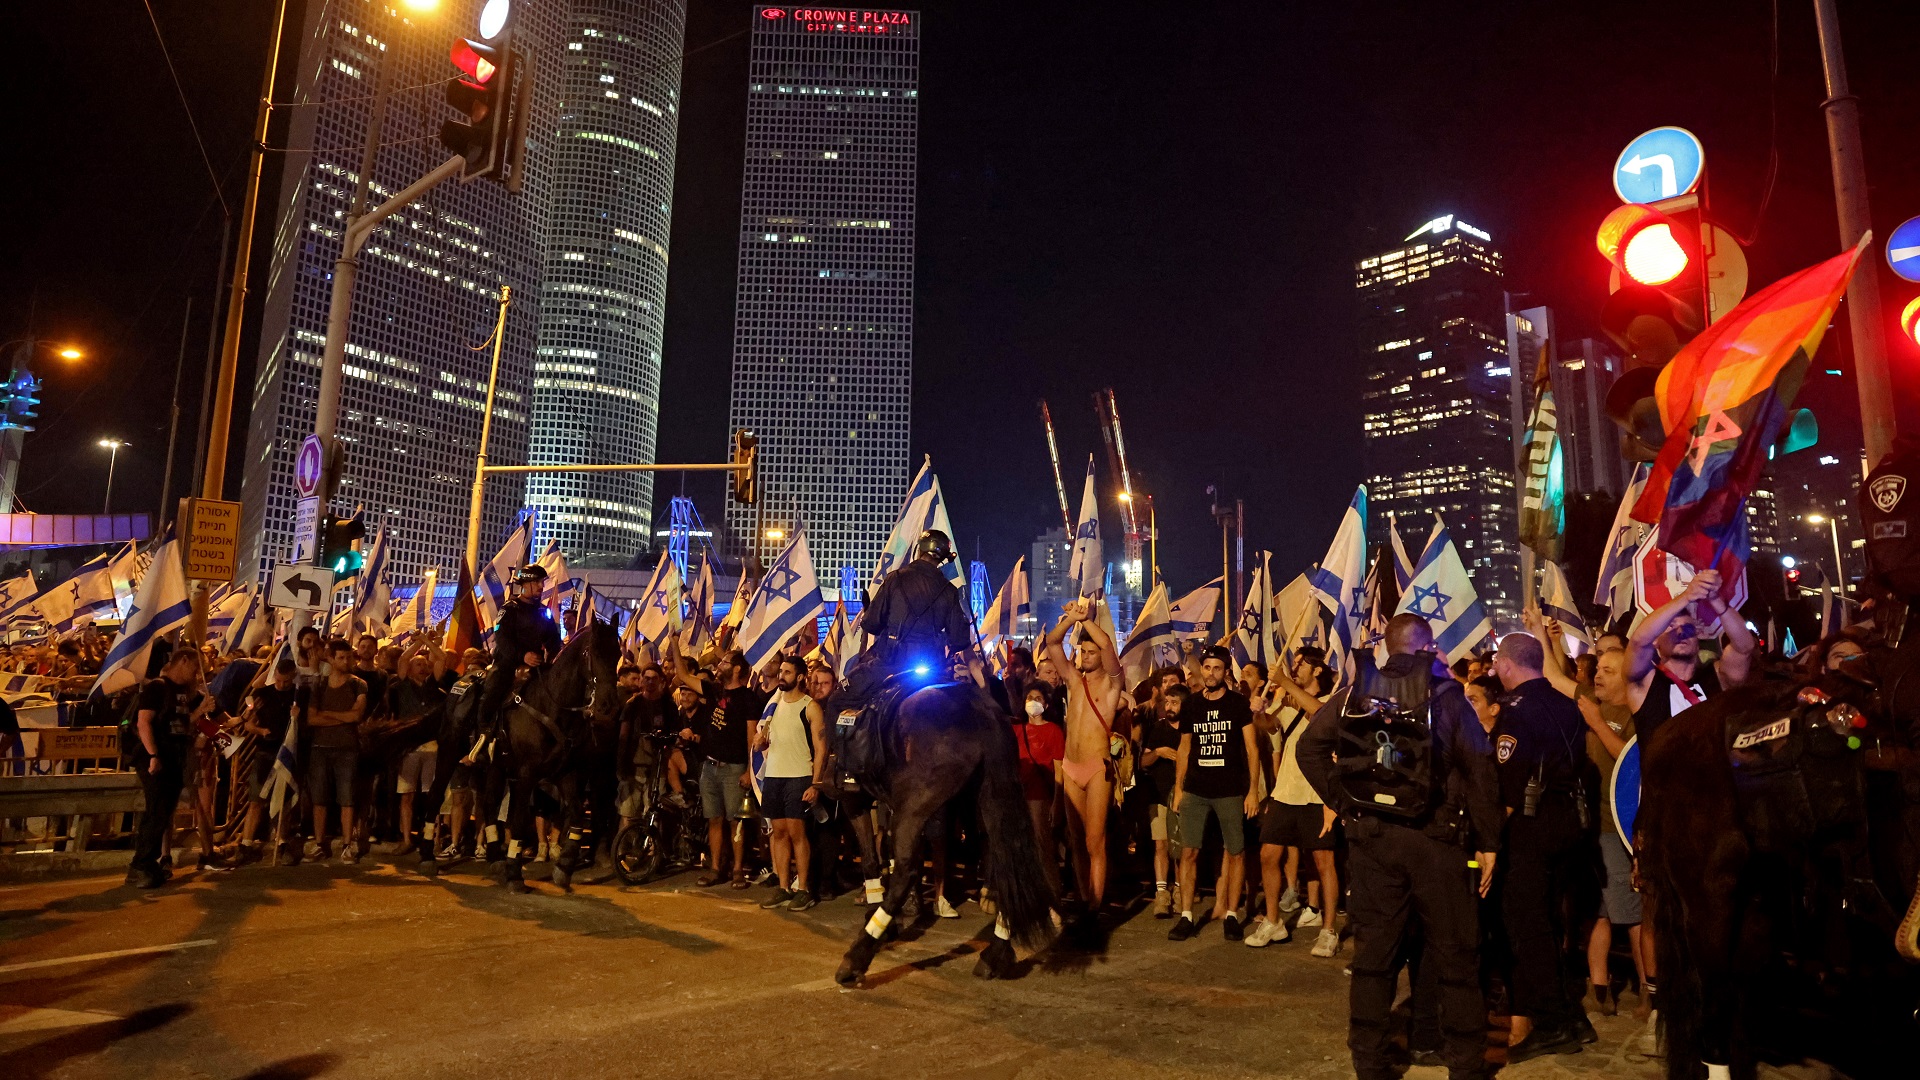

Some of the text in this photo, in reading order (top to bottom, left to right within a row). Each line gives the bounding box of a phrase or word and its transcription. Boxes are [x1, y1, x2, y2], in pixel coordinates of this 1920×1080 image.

[794, 9, 910, 24] CROWNE PLAZA
[807, 23, 889, 34] CITY CENTER
[196, 506, 231, 517] אסורה
[198, 520, 226, 531] חניית
[191, 548, 225, 560] בשטח
[1206, 709, 1219, 722] אין
[1193, 720, 1232, 733] דמוקרטיה
[1199, 733, 1227, 745] במדינת
[1200, 744, 1223, 756] הלכה
